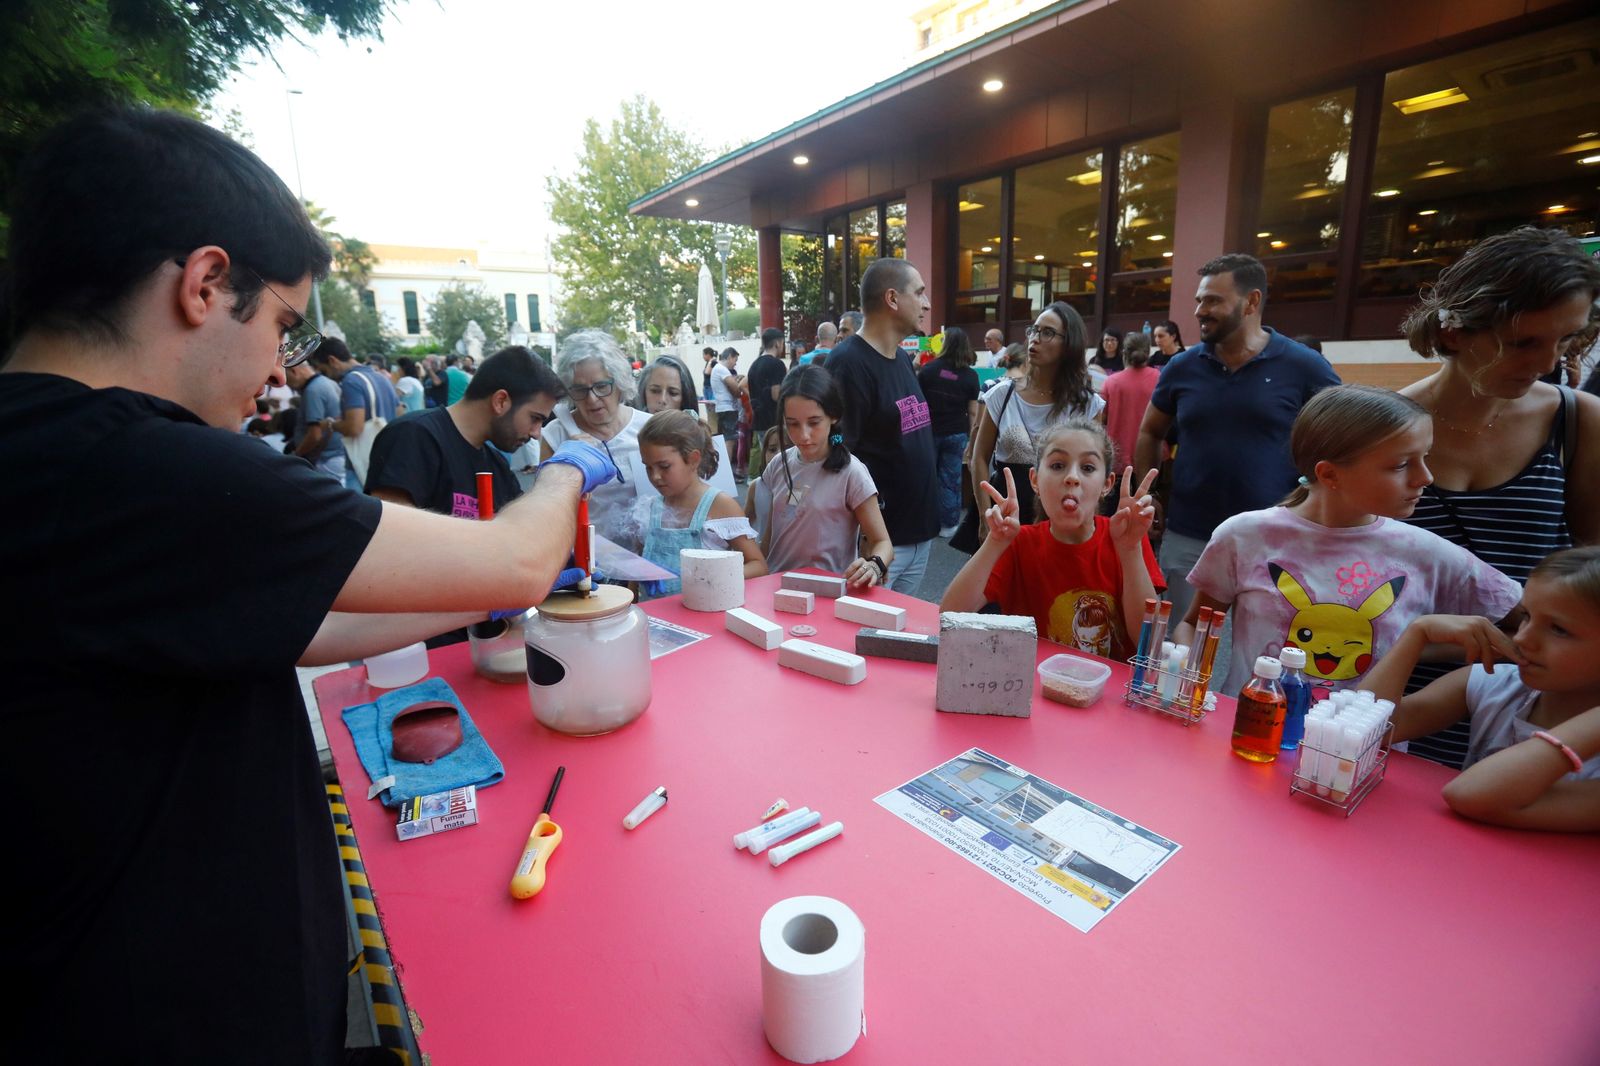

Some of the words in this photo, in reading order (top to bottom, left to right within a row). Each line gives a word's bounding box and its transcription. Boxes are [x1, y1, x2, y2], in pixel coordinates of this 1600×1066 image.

[440, 813, 466, 823] Fumar
[903, 812, 915, 820] por
[444, 820, 465, 829] mata
[914, 818, 945, 838] financiado
[991, 848, 1021, 867] Europea
[1021, 866, 1044, 881] Unión
[1017, 881, 1052, 904] Proyecto
[1052, 885, 1067, 895] por
